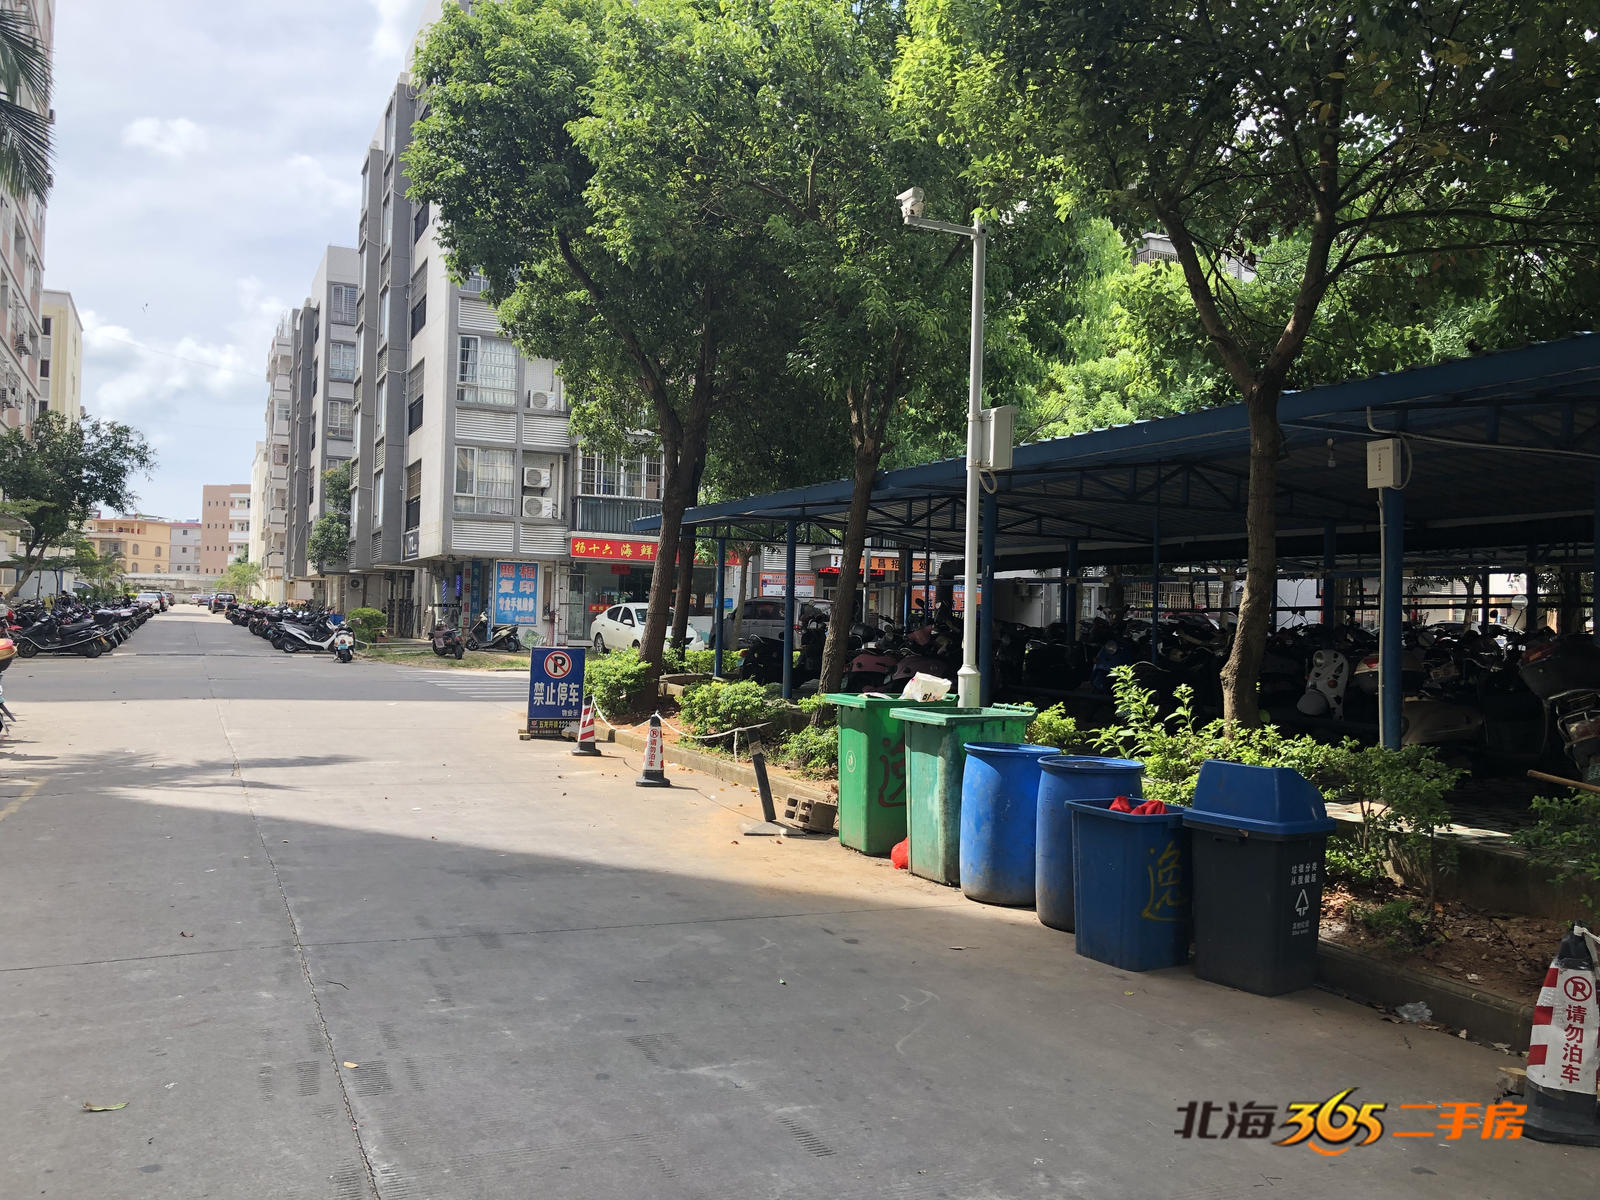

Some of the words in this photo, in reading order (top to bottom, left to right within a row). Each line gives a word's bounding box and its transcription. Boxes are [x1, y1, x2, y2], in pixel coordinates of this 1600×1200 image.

[533, 682, 579, 706] 禁止停车
[1560, 1004, 1588, 1084] 请勿泊车
